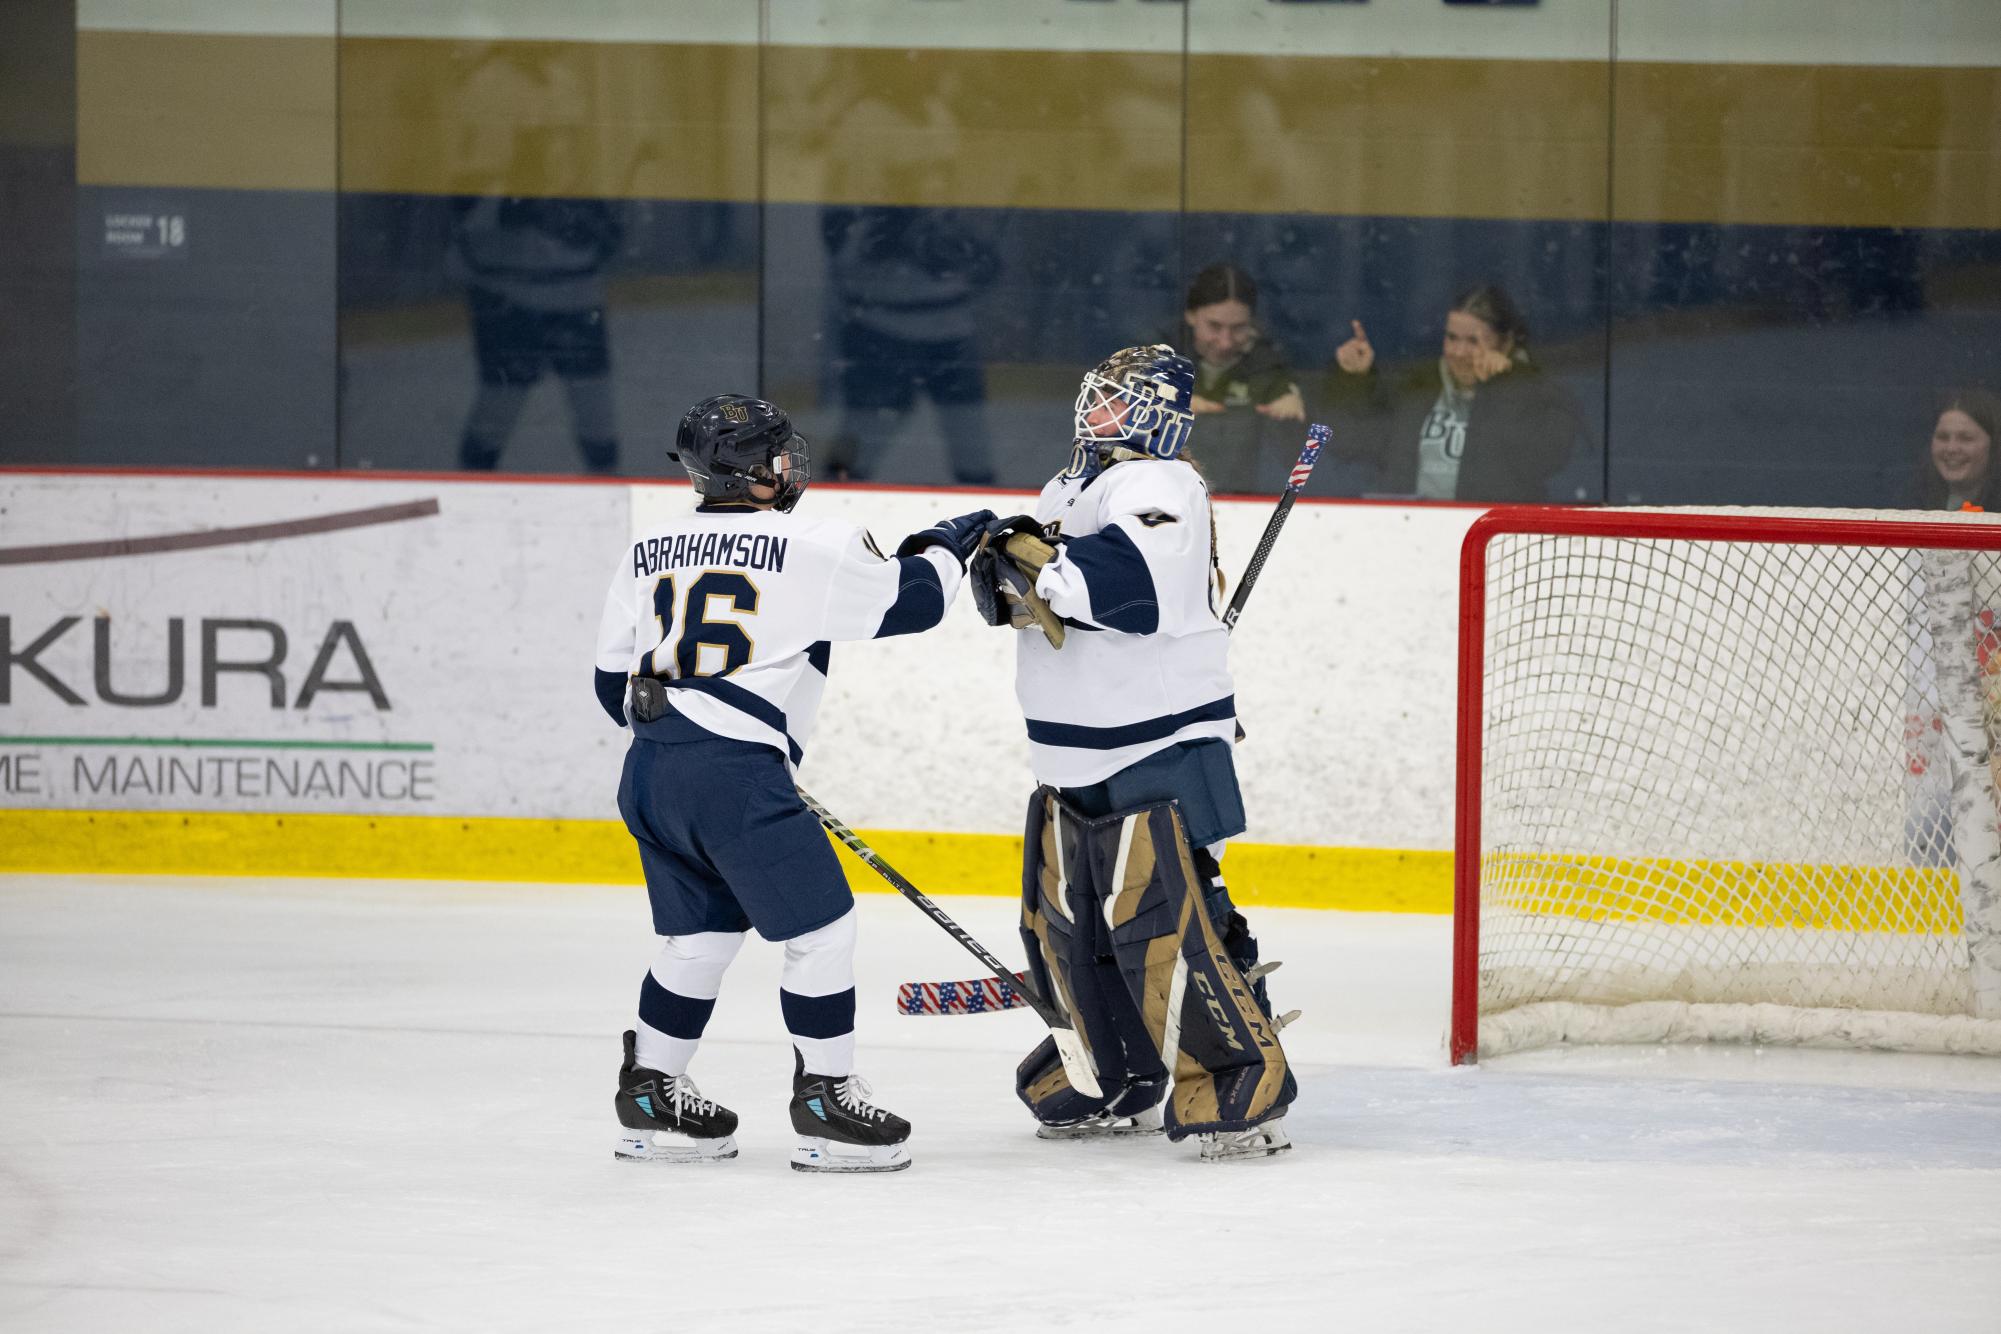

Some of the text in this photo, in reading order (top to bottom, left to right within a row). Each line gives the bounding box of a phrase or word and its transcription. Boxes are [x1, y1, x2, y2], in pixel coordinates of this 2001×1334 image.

[720, 403, 749, 422] BU
[634, 533, 788, 578] ABRAHAMSON
[629, 569, 760, 680] 16
[0, 615, 392, 711] KURA
[73, 754, 434, 801] MAINTENANCE
[1193, 971, 1245, 1050] CCM
